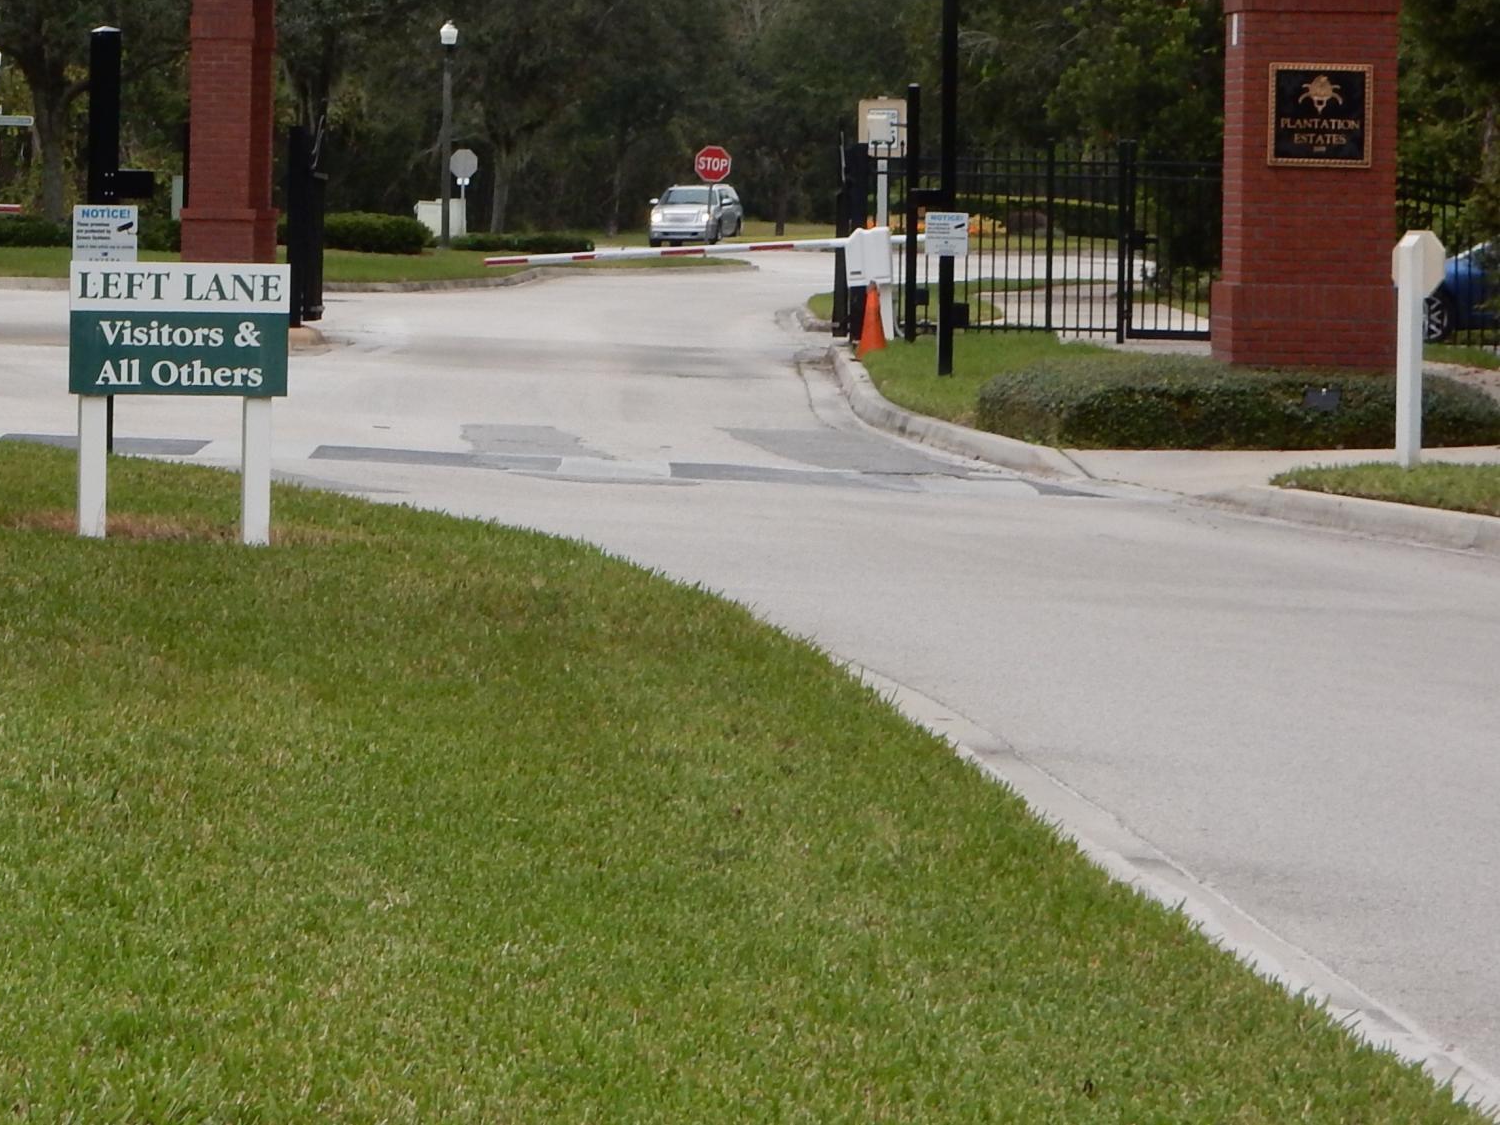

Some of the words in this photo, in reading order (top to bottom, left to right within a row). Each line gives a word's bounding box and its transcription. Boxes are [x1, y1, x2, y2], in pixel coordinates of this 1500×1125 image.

[1280, 118, 1360, 130] PLANTATION
[1293, 133, 1348, 145] ESTATES
[698, 156, 728, 172] STOP
[81, 209, 131, 218] NOTICE!
[78, 271, 171, 300] LEFT
[183, 273, 282, 303] LANE
[99, 320, 224, 347] Visitors
[234, 321, 261, 347] &
[95, 359, 141, 386] All
[151, 359, 264, 387] Others
